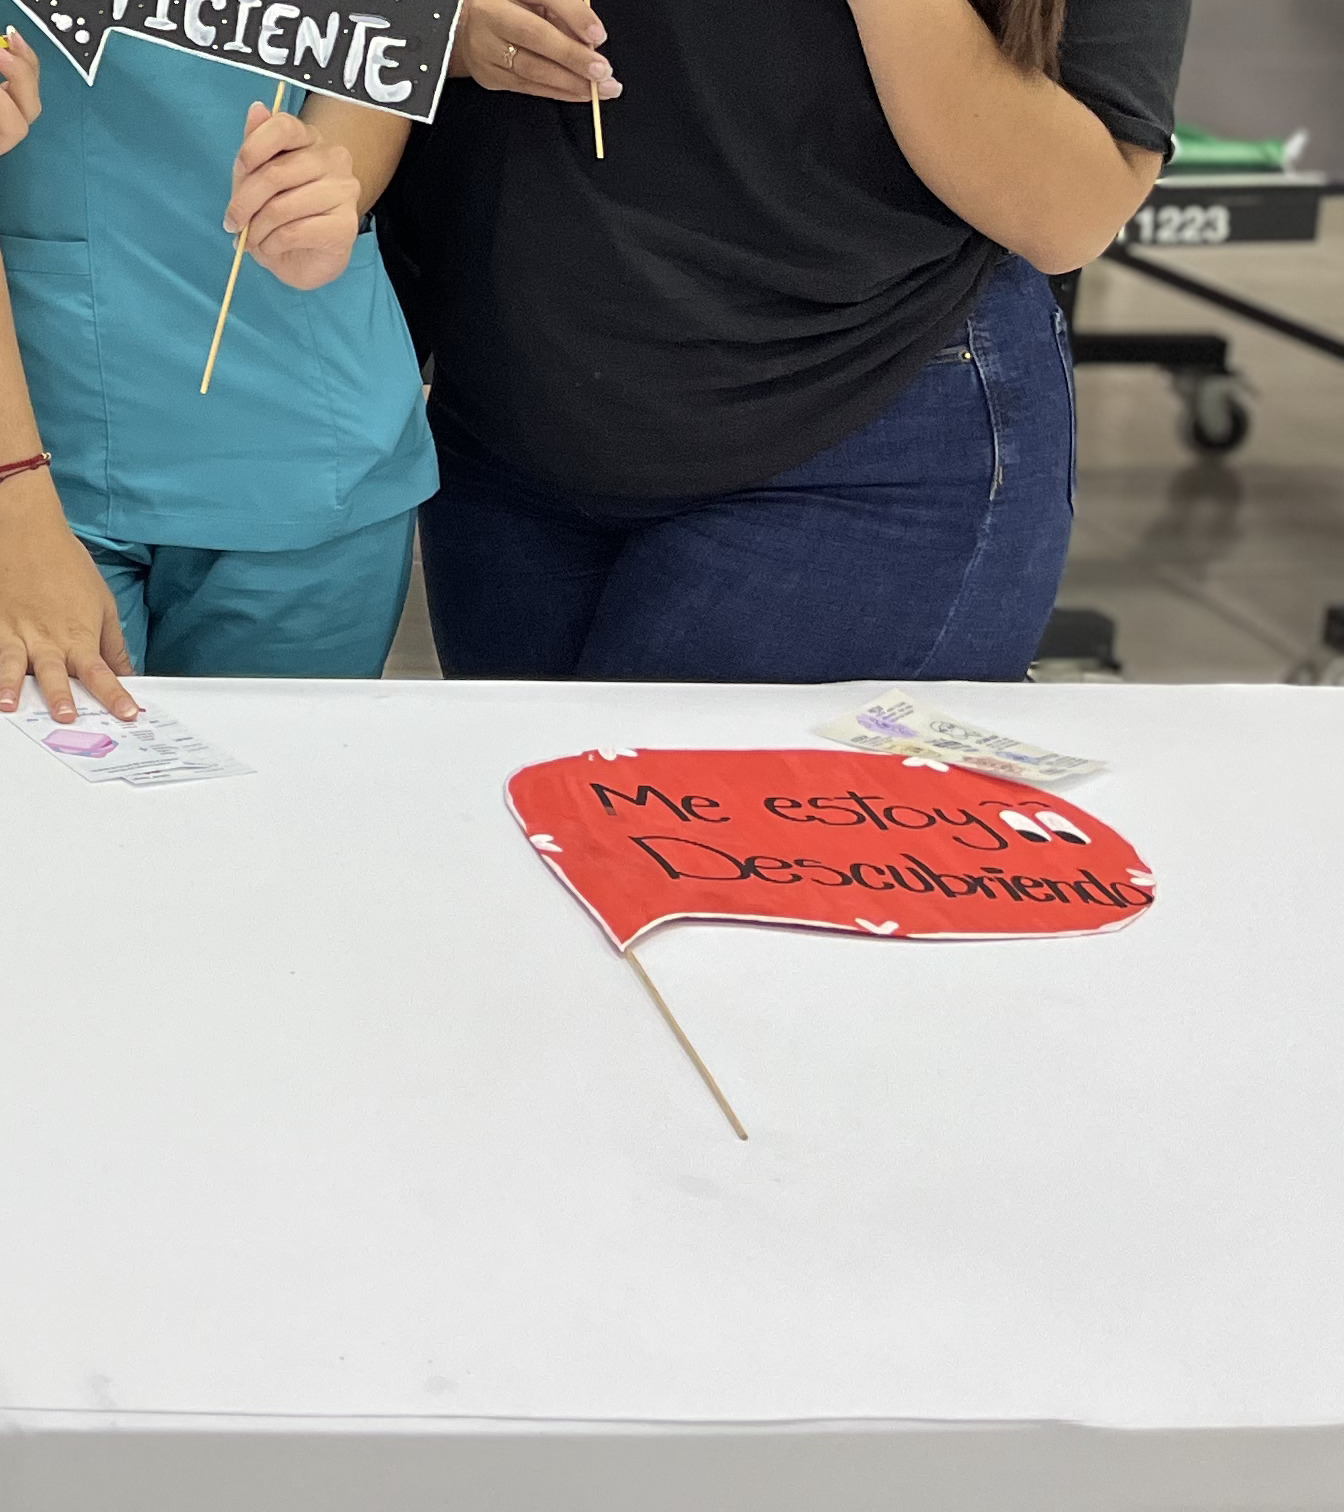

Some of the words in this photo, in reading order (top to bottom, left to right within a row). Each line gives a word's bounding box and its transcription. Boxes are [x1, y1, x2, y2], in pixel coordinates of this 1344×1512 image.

[1116, 205, 1231, 244] 1223
[588, 781, 731, 824] Me
[764, 789, 1009, 851] estoy
[628, 834, 1155, 909] Descubriendo
